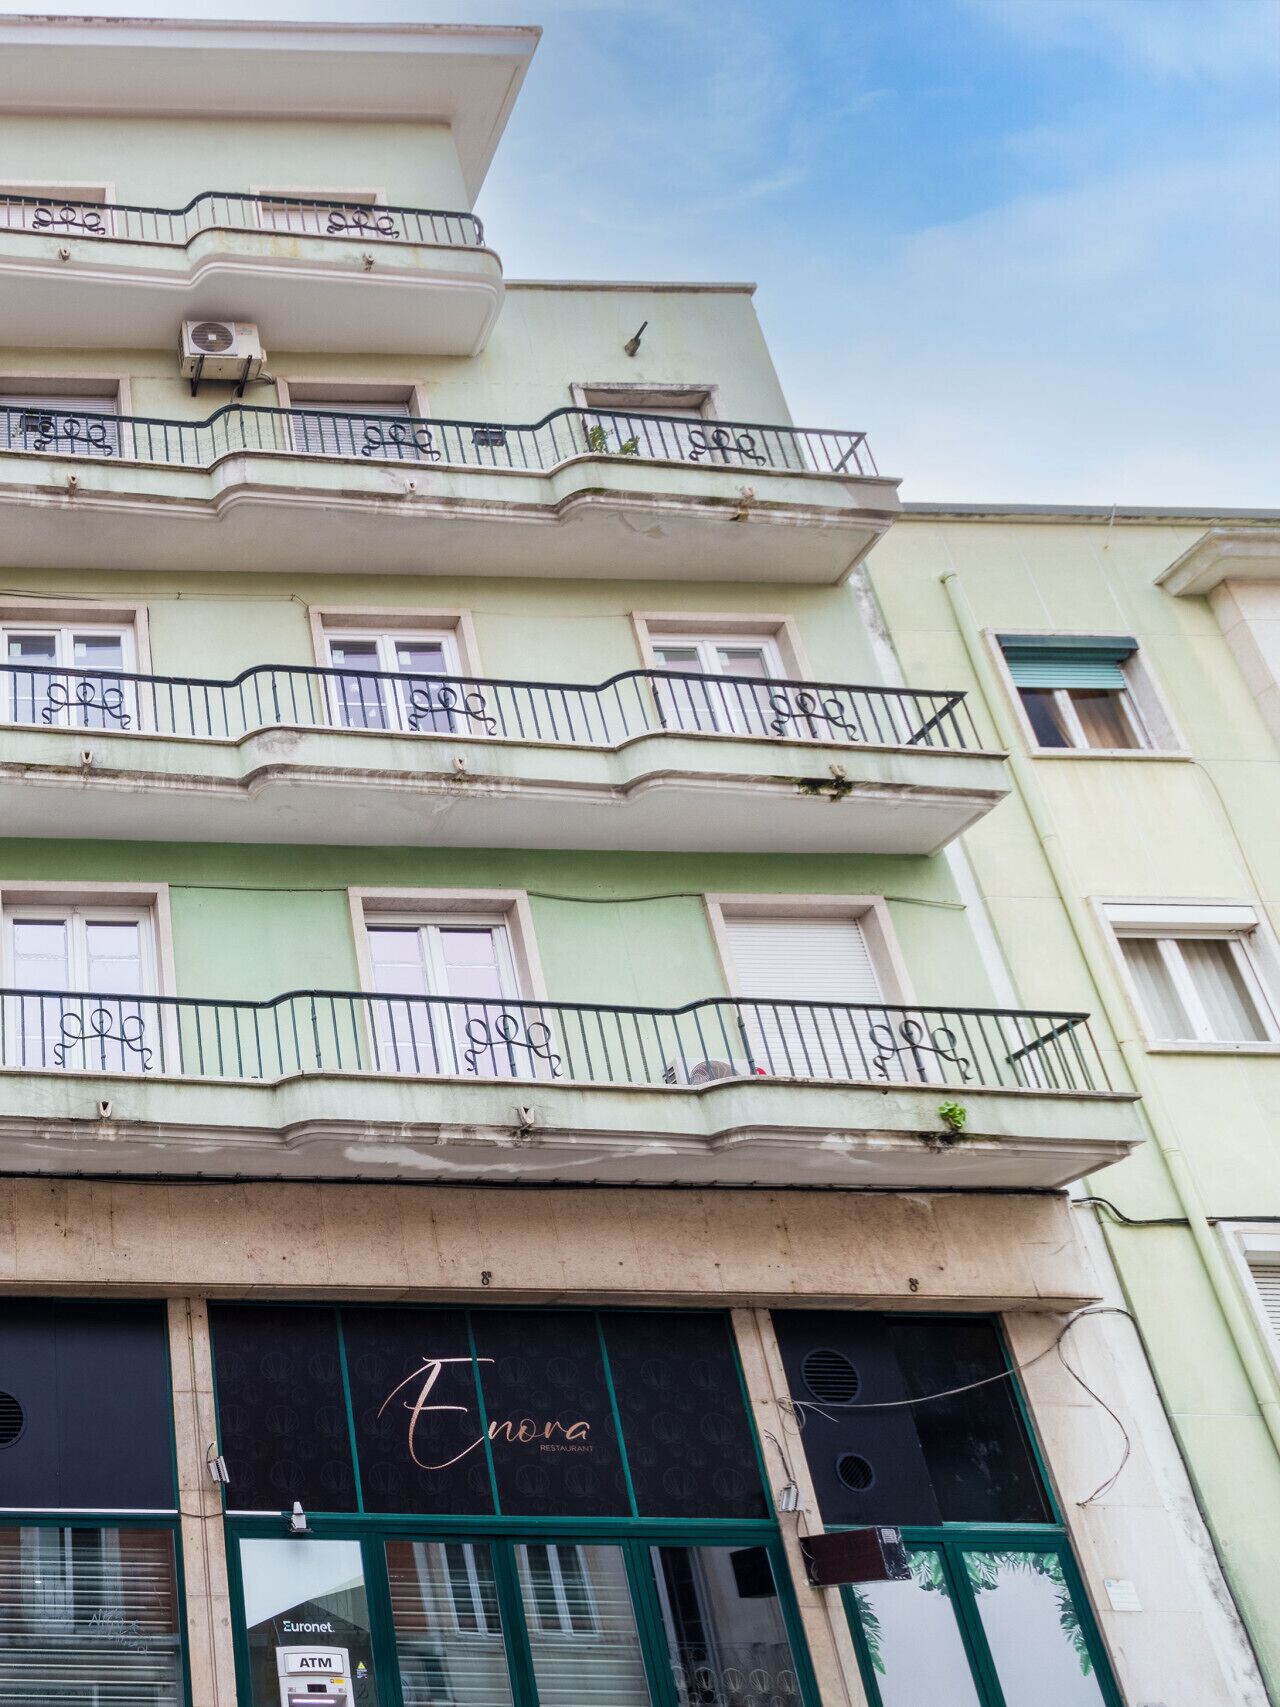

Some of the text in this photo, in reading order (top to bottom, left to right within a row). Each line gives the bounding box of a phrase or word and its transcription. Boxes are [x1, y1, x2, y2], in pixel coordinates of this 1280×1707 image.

[377, 1356, 590, 1470] Enora
[540, 1444, 593, 1453] RESTAURANT
[300, 1658, 332, 1668] ATM
